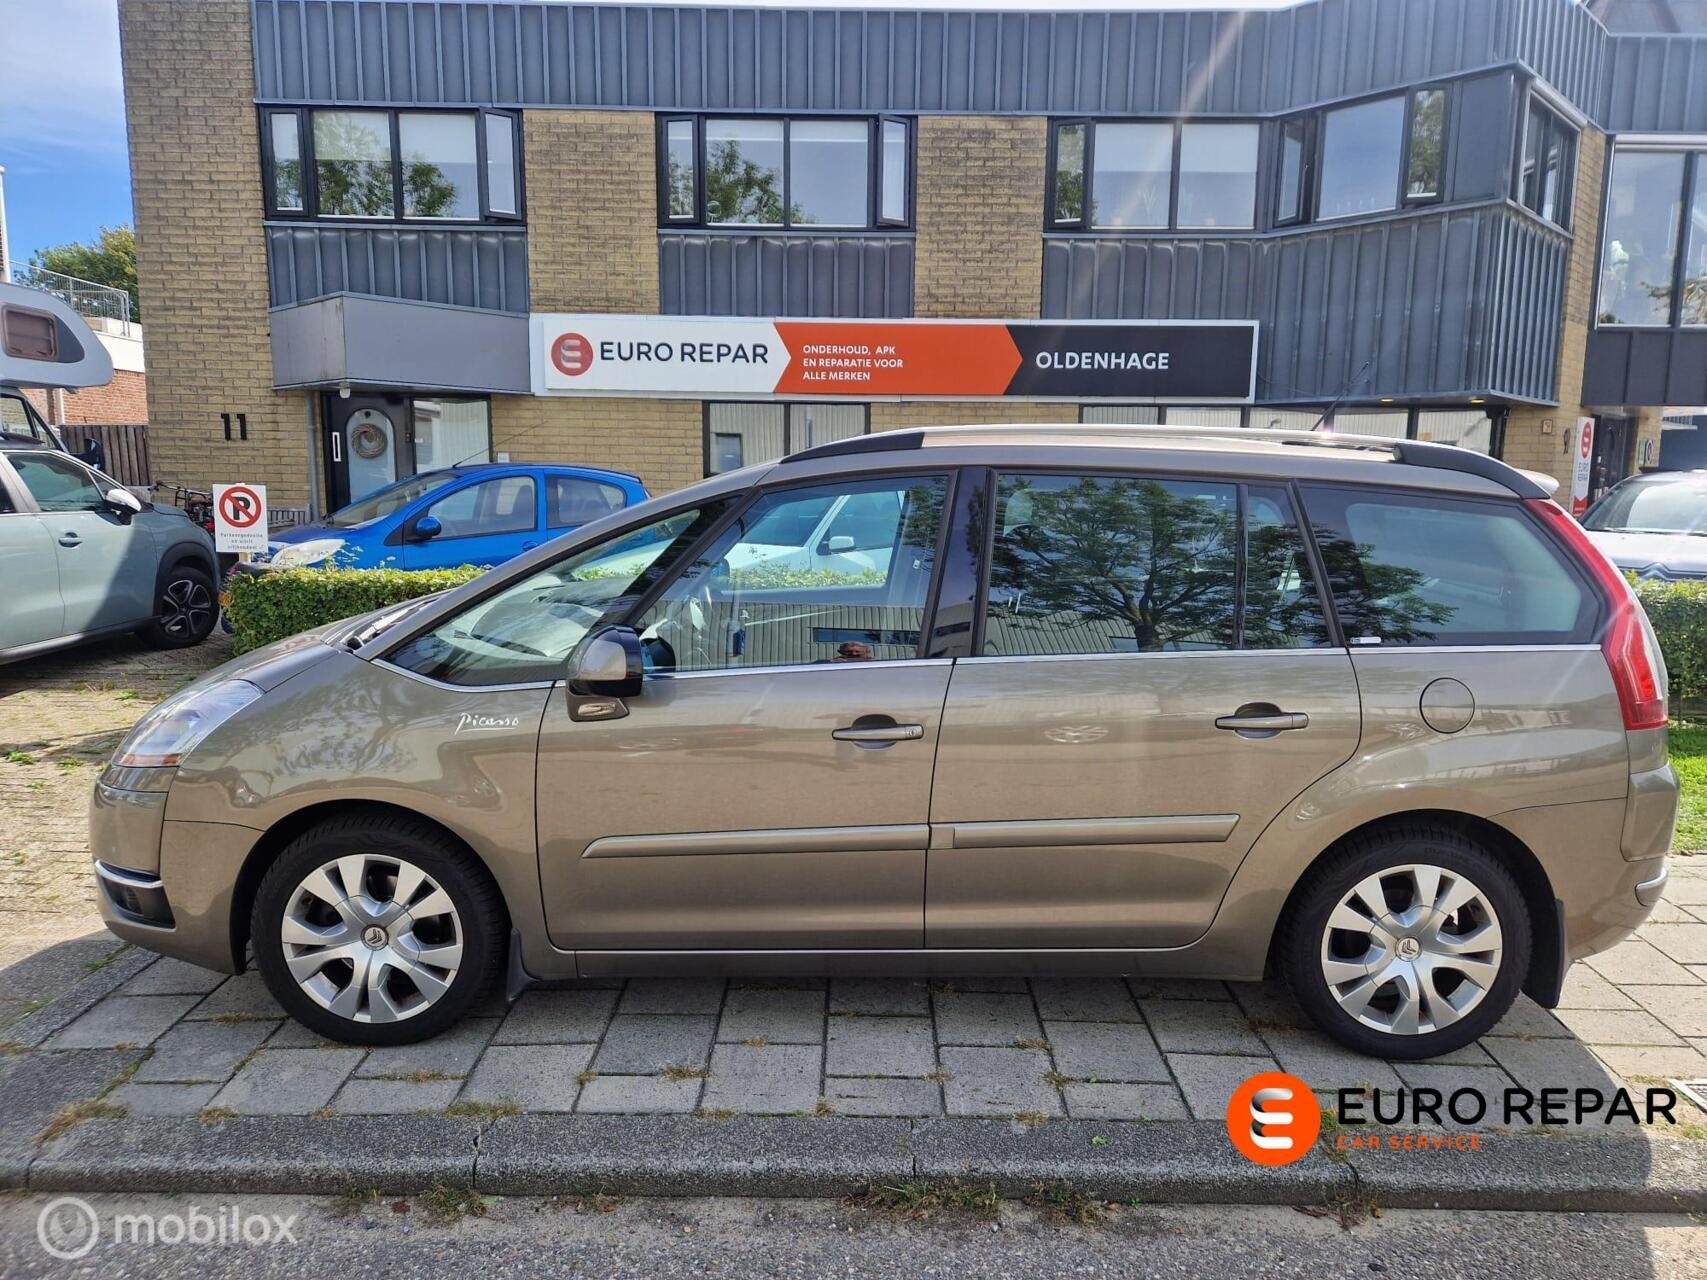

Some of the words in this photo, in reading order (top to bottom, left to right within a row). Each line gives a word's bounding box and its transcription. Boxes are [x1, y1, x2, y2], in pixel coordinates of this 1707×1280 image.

[600, 341, 673, 362] EURO
[680, 342, 769, 364] REPAR
[803, 345, 871, 355] ONDERHOUD,
[875, 346, 896, 354] APK
[803, 358, 817, 367] EN
[819, 358, 872, 367] REPARATIE
[874, 359, 904, 368] VOOR
[1035, 351, 1170, 369] OLDENHAGE
[803, 371, 827, 380] ALLE
[829, 371, 871, 380] MERKEN
[221, 412, 248, 441] 11
[454, 712, 520, 735] Picasso
